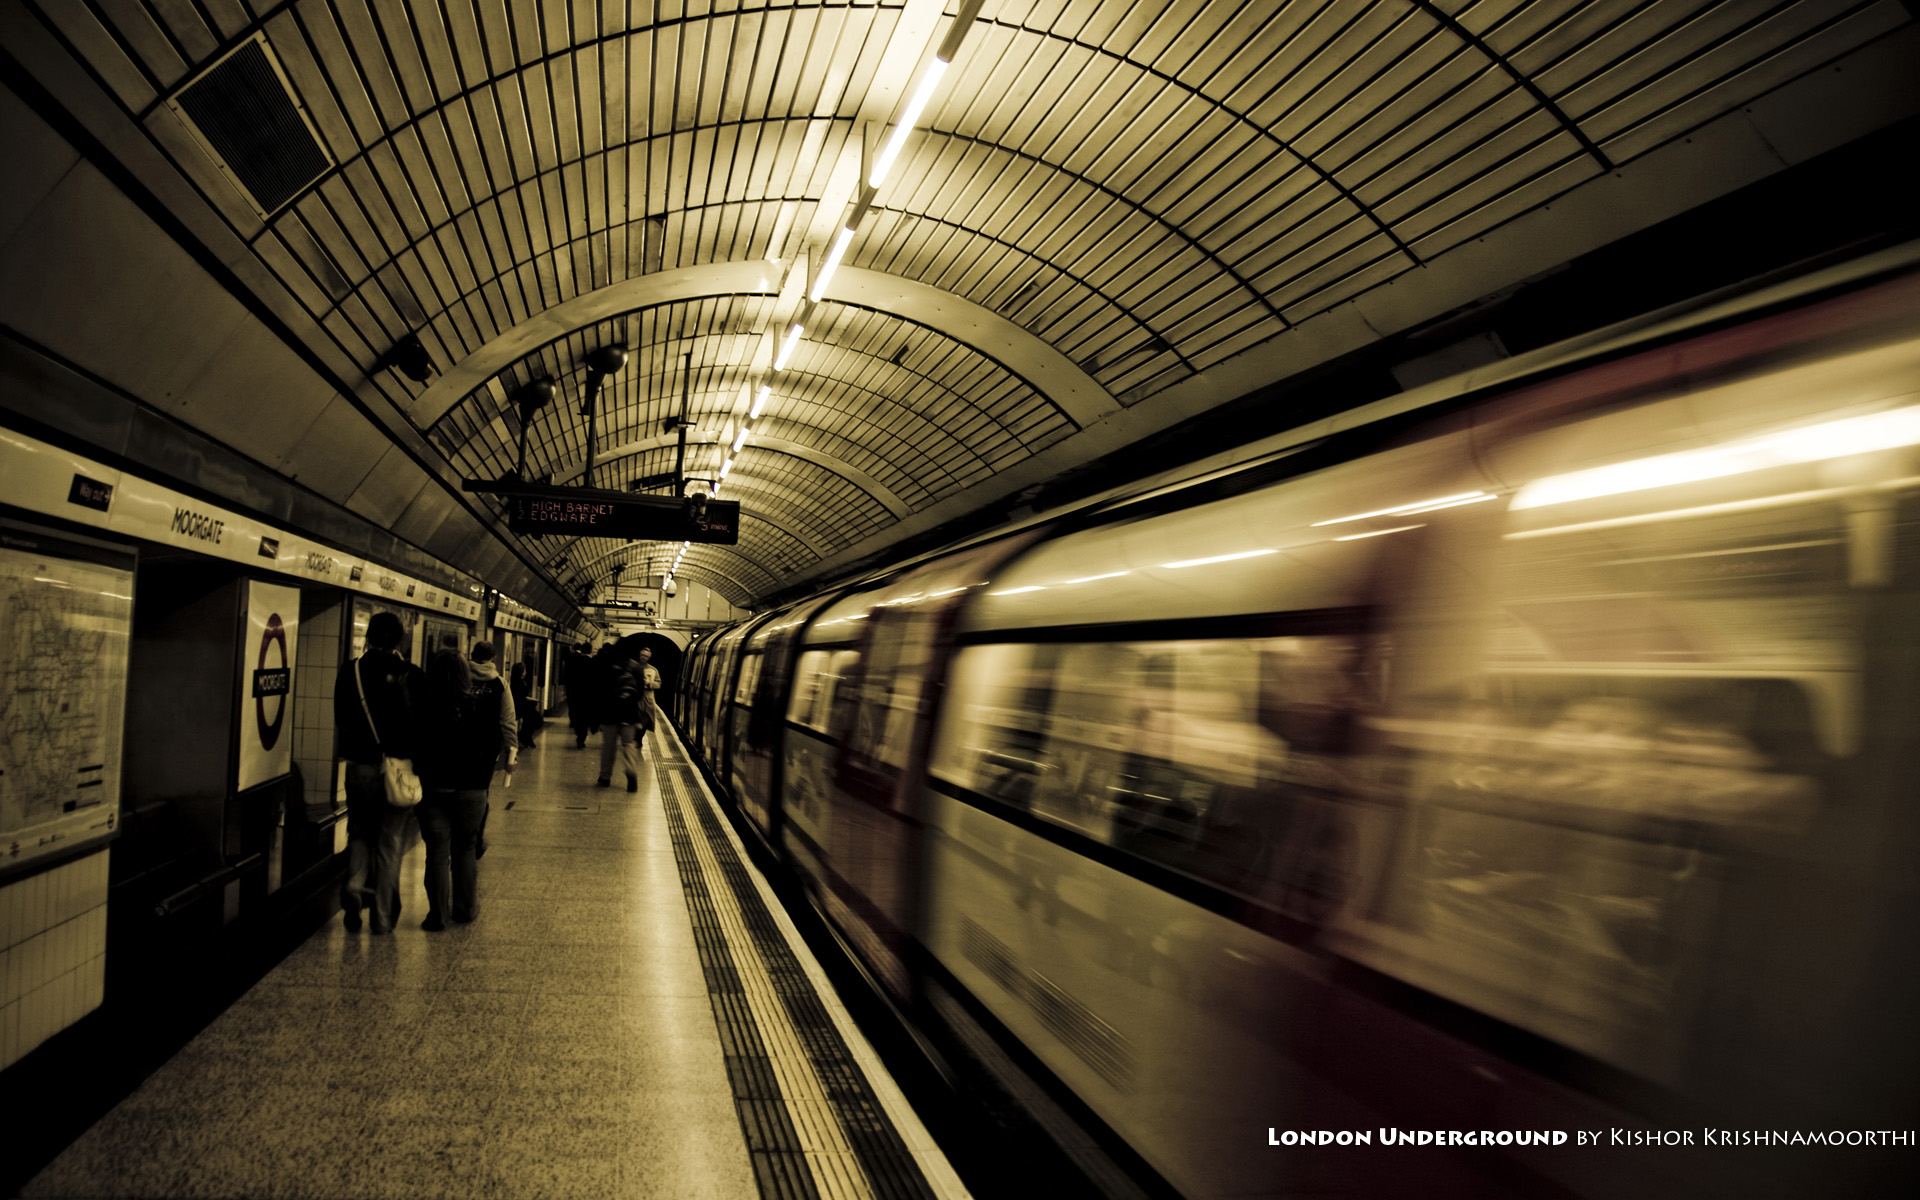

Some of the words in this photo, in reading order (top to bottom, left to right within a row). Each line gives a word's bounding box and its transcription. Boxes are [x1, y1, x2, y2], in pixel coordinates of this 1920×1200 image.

[79, 481, 93, 501] Way
[517, 509, 525, 520] 2
[530, 510, 597, 524] EDGWARE
[518, 500, 524, 510] 1
[531, 501, 561, 512] HIGH
[566, 502, 615, 515] BARNET
[170, 507, 225, 544] MOORGATE
[258, 672, 286, 692] MOORGATE
